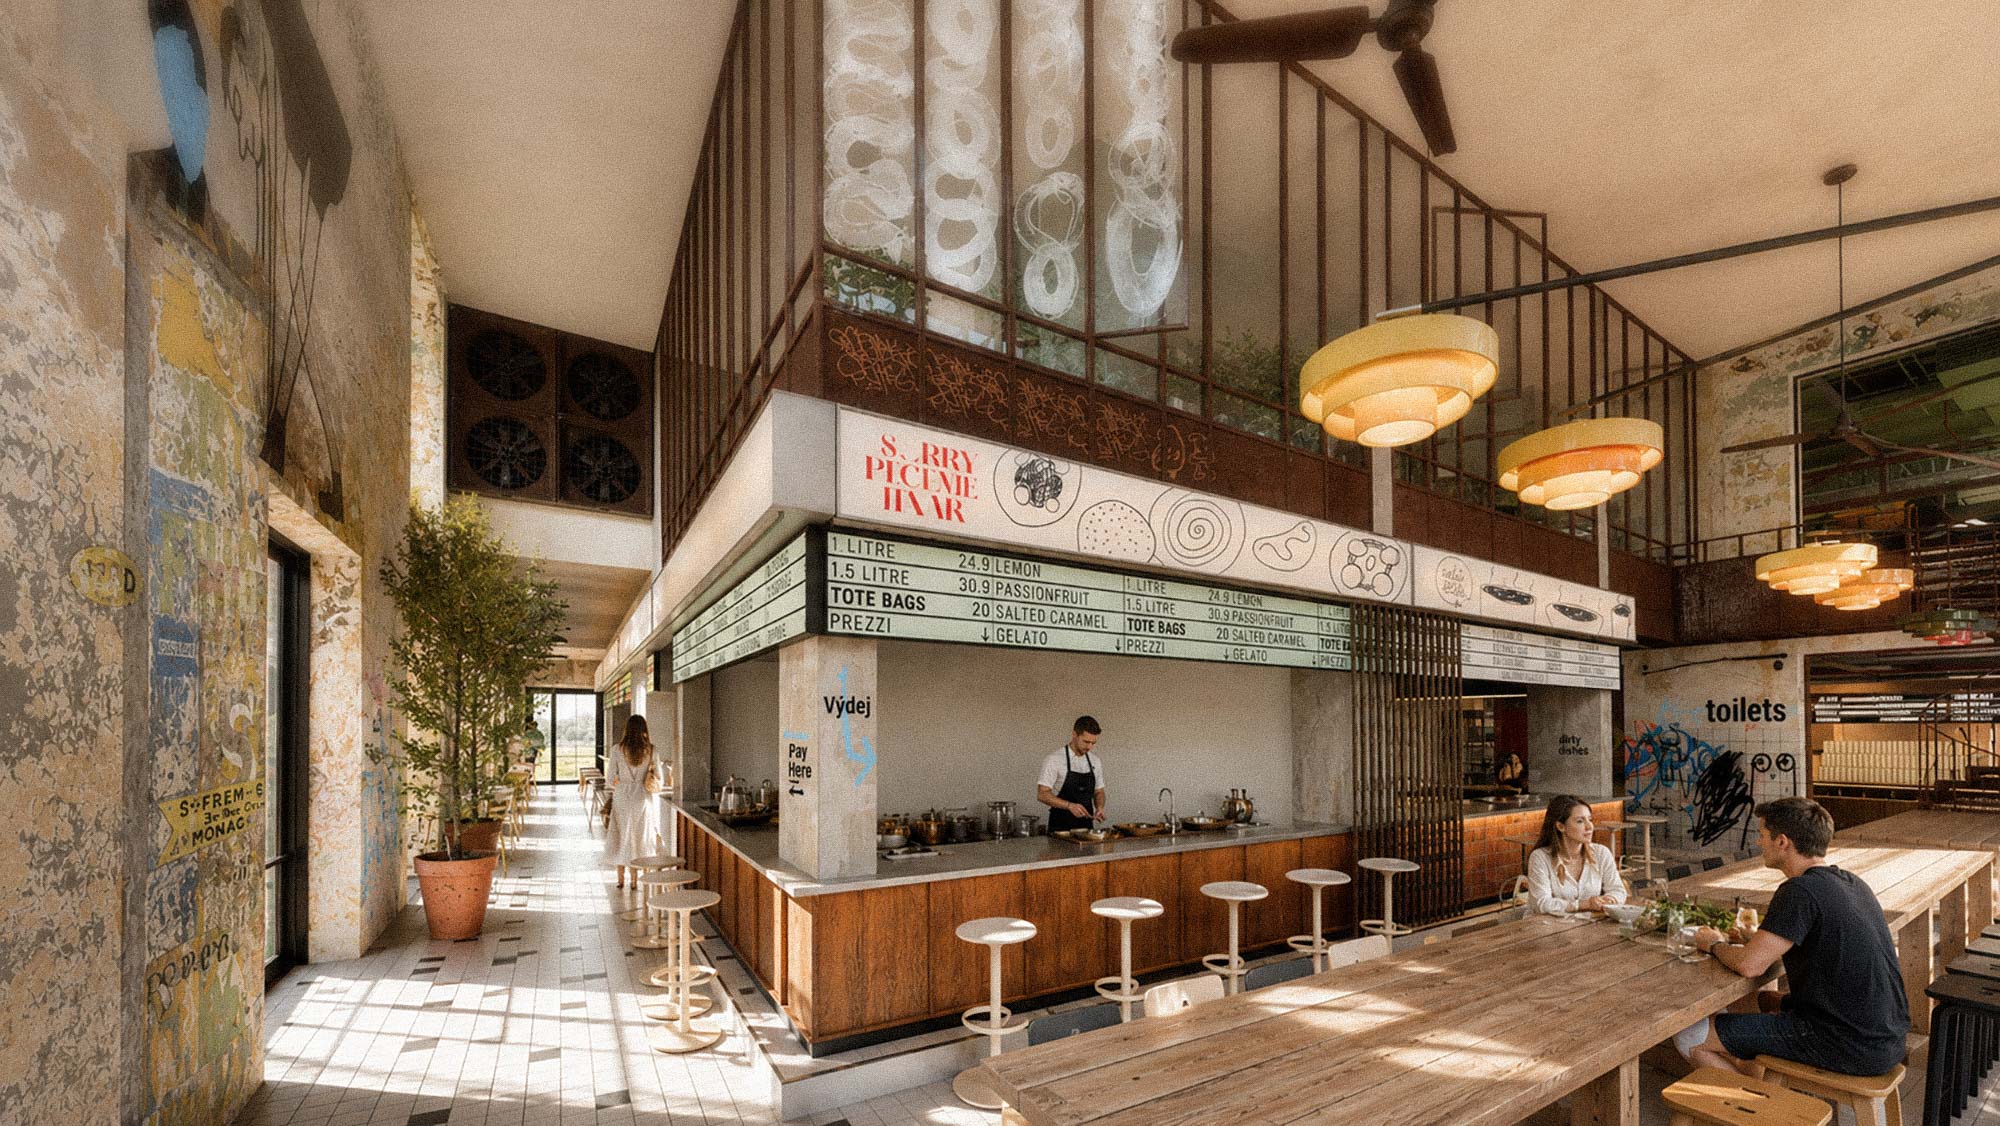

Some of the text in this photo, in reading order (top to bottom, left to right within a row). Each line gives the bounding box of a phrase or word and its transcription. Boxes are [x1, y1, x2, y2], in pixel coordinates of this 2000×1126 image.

[847, 539, 896, 559] LITRE
[958, 553, 991, 572] 24.9
[831, 561, 991, 594] 1.5 LITRE 30.9
[995, 558, 1041, 578] LEMON
[995, 582, 1090, 606] PASSIONFRUIT
[1136, 579, 1166, 595] LITRE
[831, 586, 990, 618] TOTE BAGS 20
[1232, 591, 1263, 607] LEMON
[995, 604, 1108, 630] SALTED CARAMEL
[1126, 598, 1230, 622] 1.5 LITRE 30.9
[1232, 610, 1294, 629] PASSIONFRUIT
[830, 613, 892, 633] PREZZI
[1127, 617, 1229, 640] TOTE BAGS 20
[996, 627, 1048, 646] GELATO
[1126, 639, 1166, 654] PREZZI
[1232, 628, 1306, 648] SALTED CARAMEL
[1232, 648, 1268, 662] GELATO
[823, 695, 871, 719] Výdej
[1706, 697, 1786, 723] toilets
[1559, 734, 1581, 747] dirty
[788, 743, 808, 763] Pay
[788, 761, 812, 779] Here
